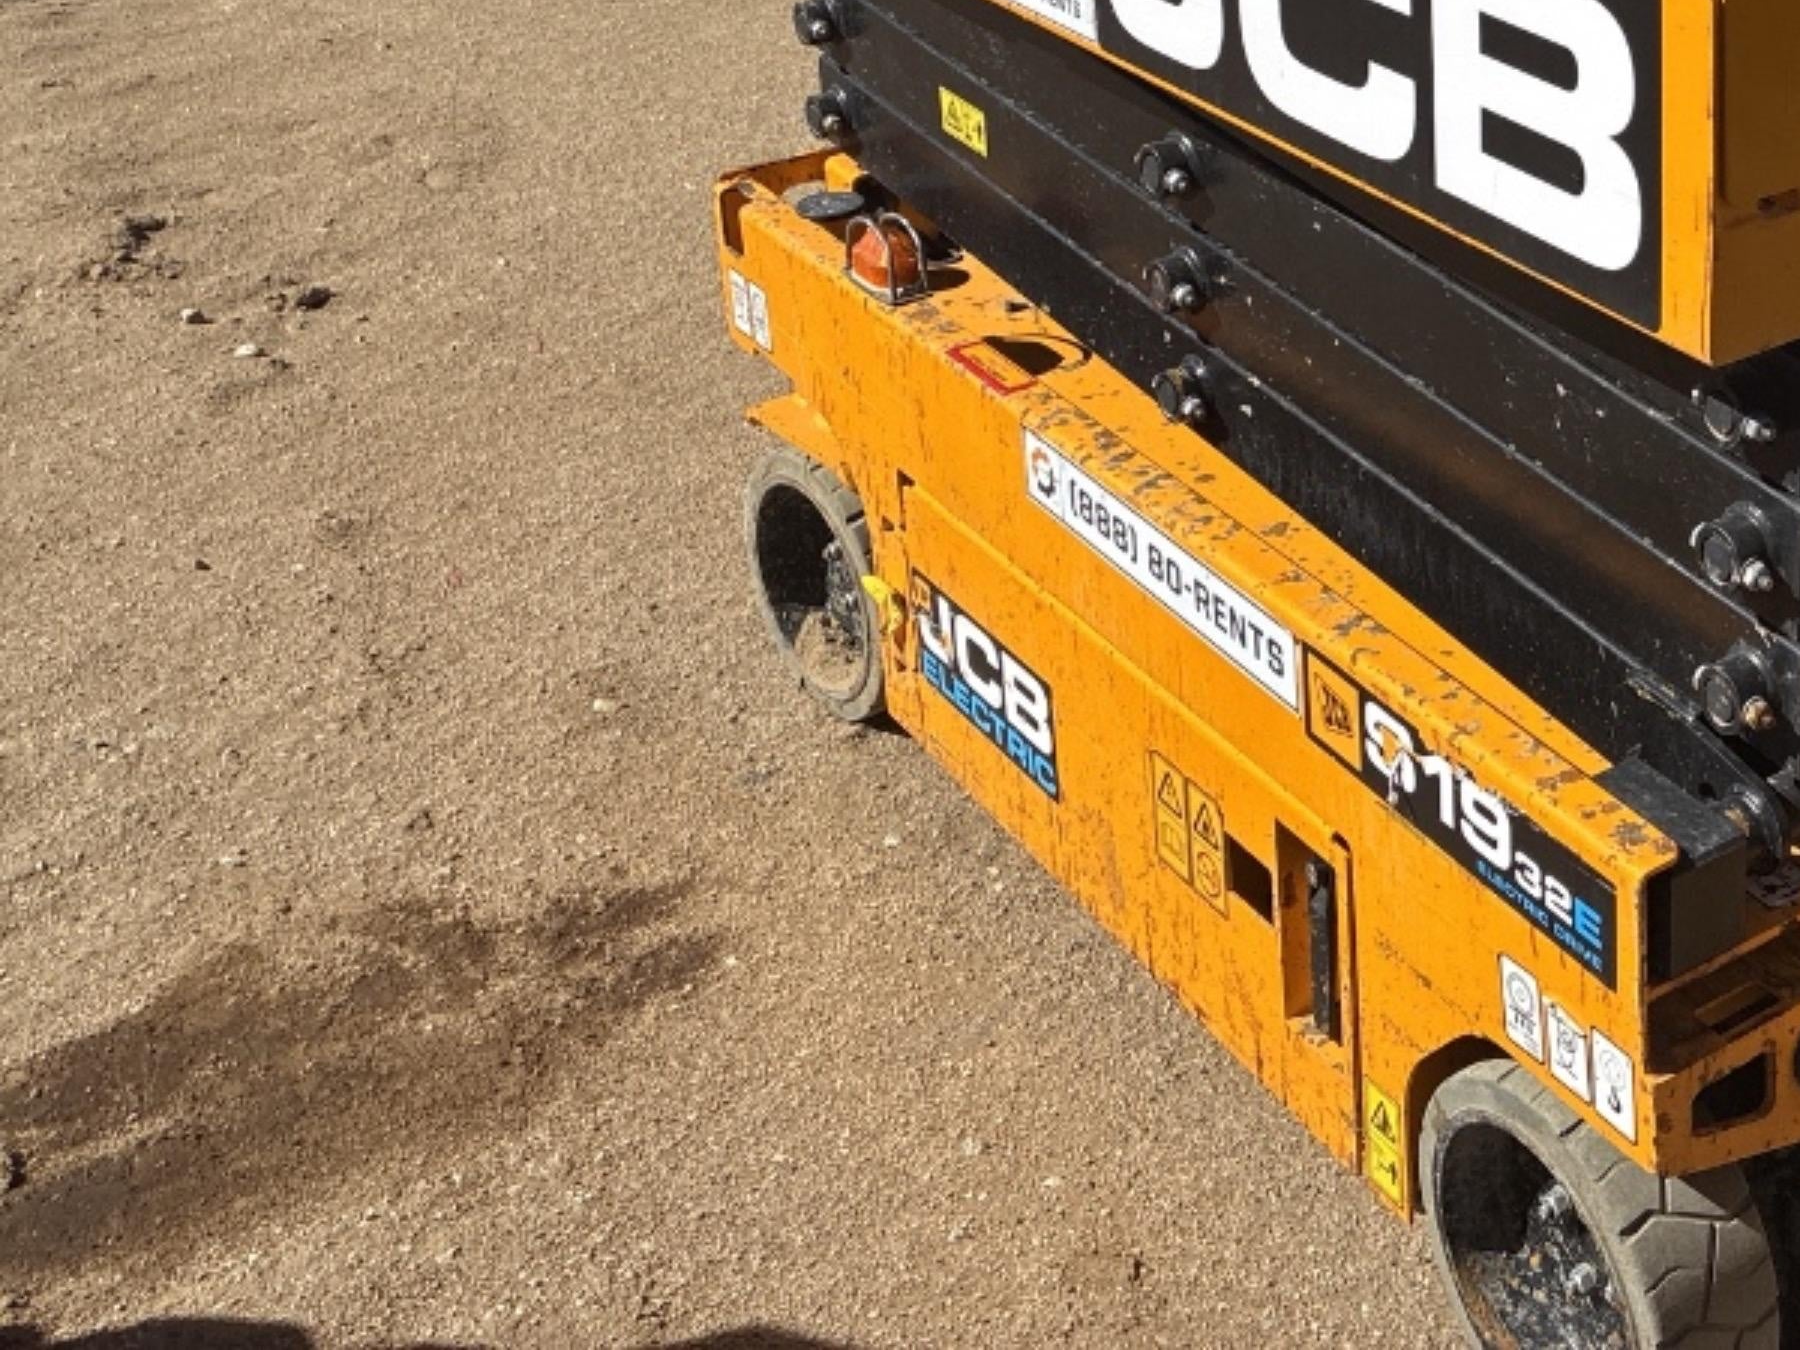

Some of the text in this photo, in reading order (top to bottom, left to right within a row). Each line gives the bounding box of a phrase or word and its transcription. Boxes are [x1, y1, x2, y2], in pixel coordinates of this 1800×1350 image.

[1068, 477, 1138, 565] (888)
[917, 595, 1055, 755] JCB
[922, 648, 1058, 797] ELECTRIC
[1513, 851, 1603, 950] 32E
